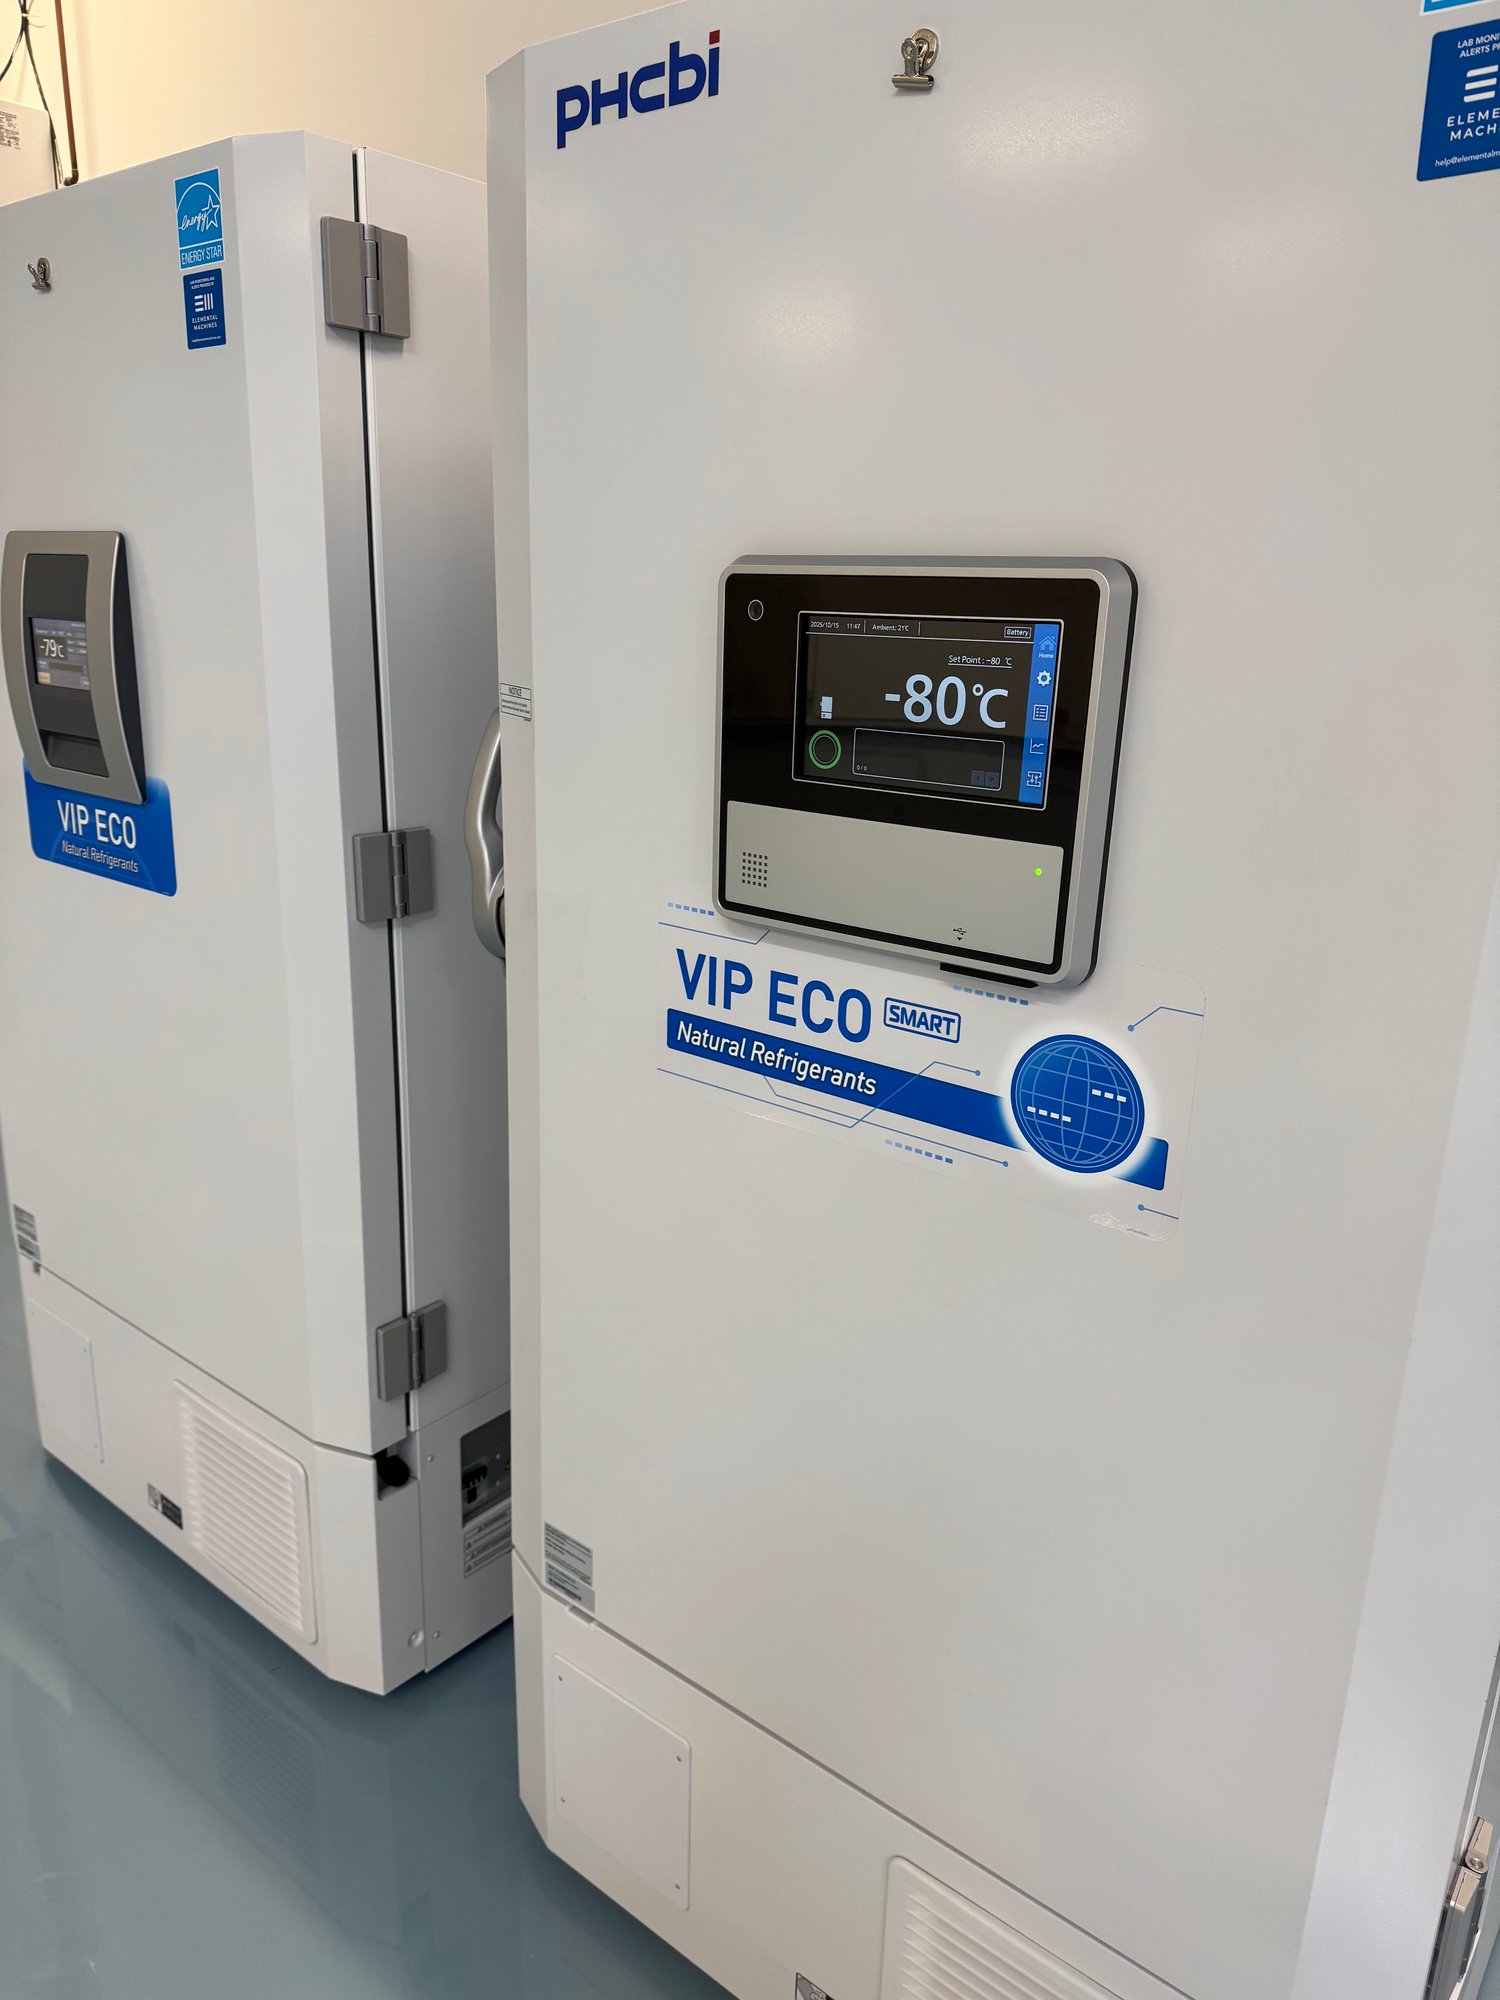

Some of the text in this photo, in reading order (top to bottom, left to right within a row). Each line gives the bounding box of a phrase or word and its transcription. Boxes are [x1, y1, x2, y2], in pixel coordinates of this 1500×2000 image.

[1457, 38, 1474, 49] LAB
[1459, 44, 1491, 58] ALERTS
[1447, 107, 1500, 128] ELEME
[181, 244, 223, 266] ENERGY STAR
[191, 314, 219, 324] ELEMENTAL
[193, 321, 218, 331] MACHINES
[810, 621, 840, 630] 2025/10/15
[871, 623, 897, 632] Ambient:
[1006, 628, 1030, 638] Battery
[948, 655, 961, 664] Set
[1038, 652, 1055, 660] Home
[57, 799, 137, 850] VIP ECO
[61, 840, 139, 873] Natural Refrigerants
[676, 948, 956, 1043] VIP ECO SMART
[676, 1020, 877, 1096] Natural Refrigerants
